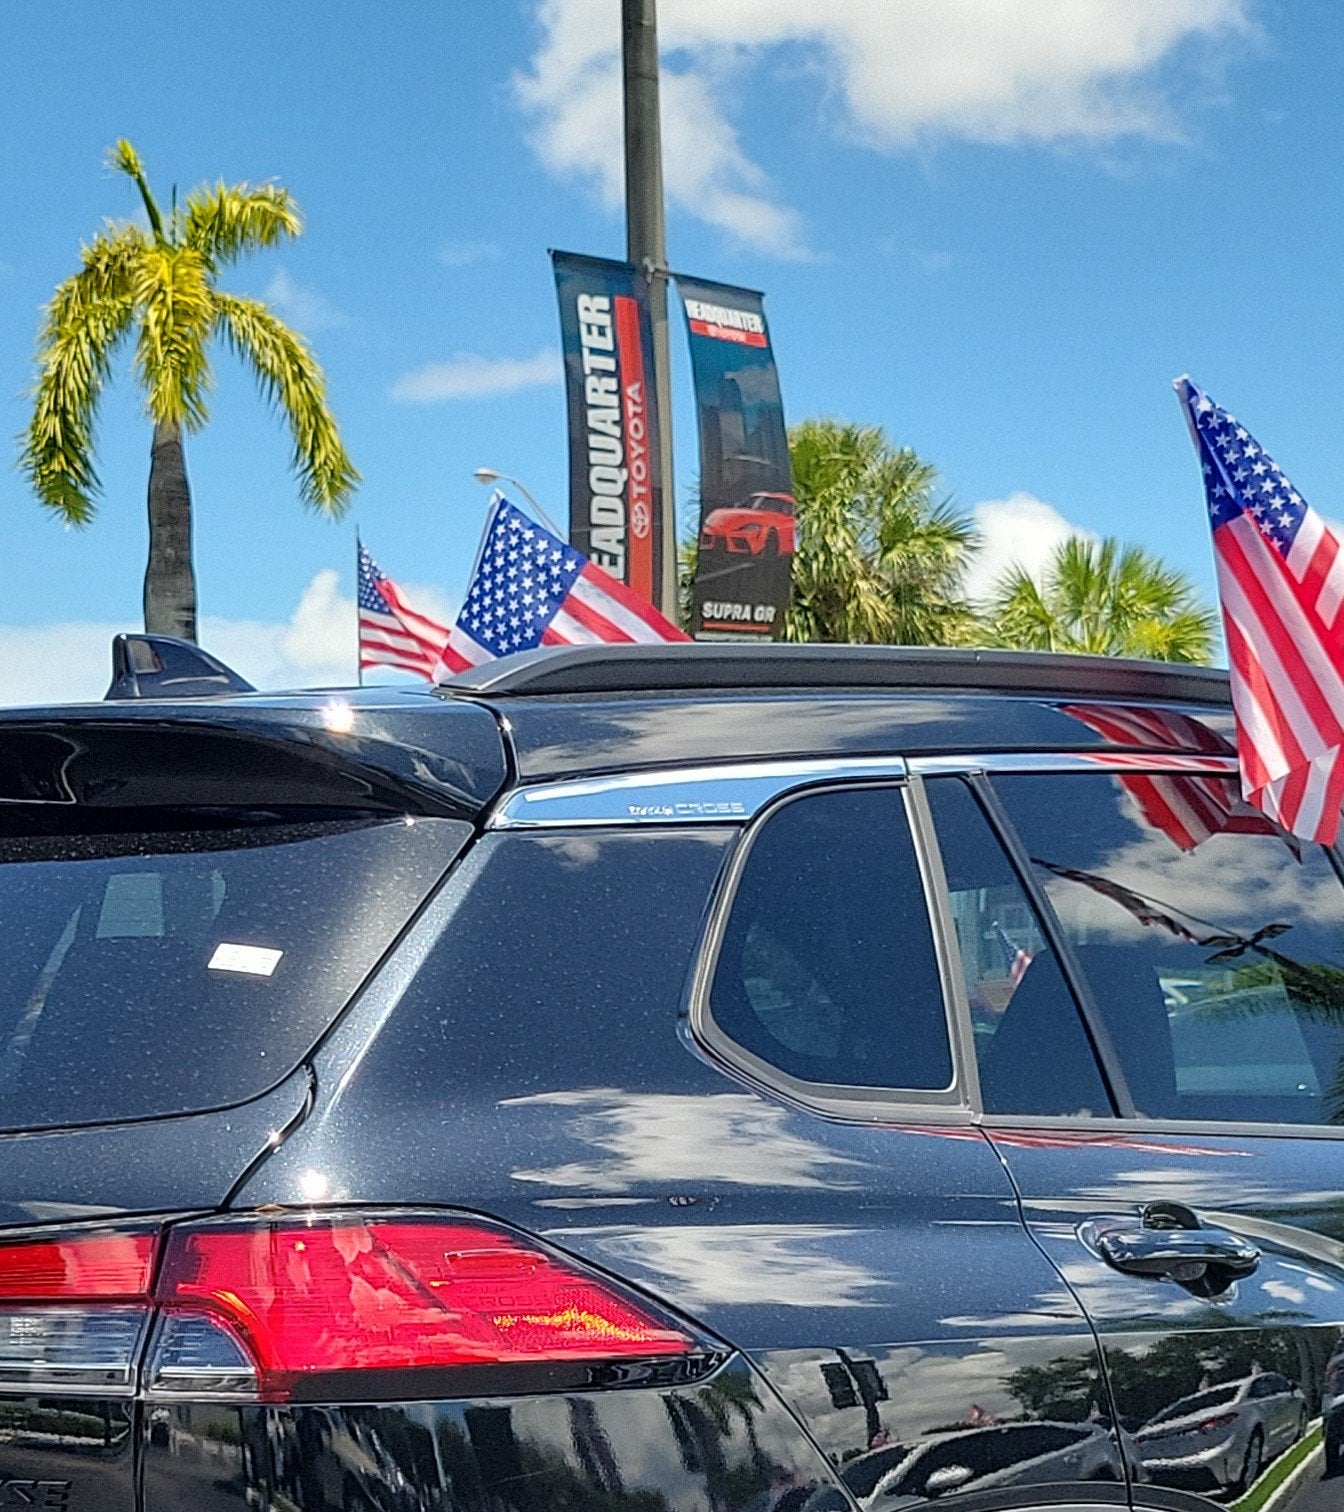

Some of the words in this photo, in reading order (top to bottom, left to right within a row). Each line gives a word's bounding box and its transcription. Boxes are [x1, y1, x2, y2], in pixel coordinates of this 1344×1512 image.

[577, 294, 627, 582] EADQUARTER
[628, 381, 648, 496] TOYOTA
[702, 601, 752, 620] SUPRA
[753, 604, 776, 622] GR
